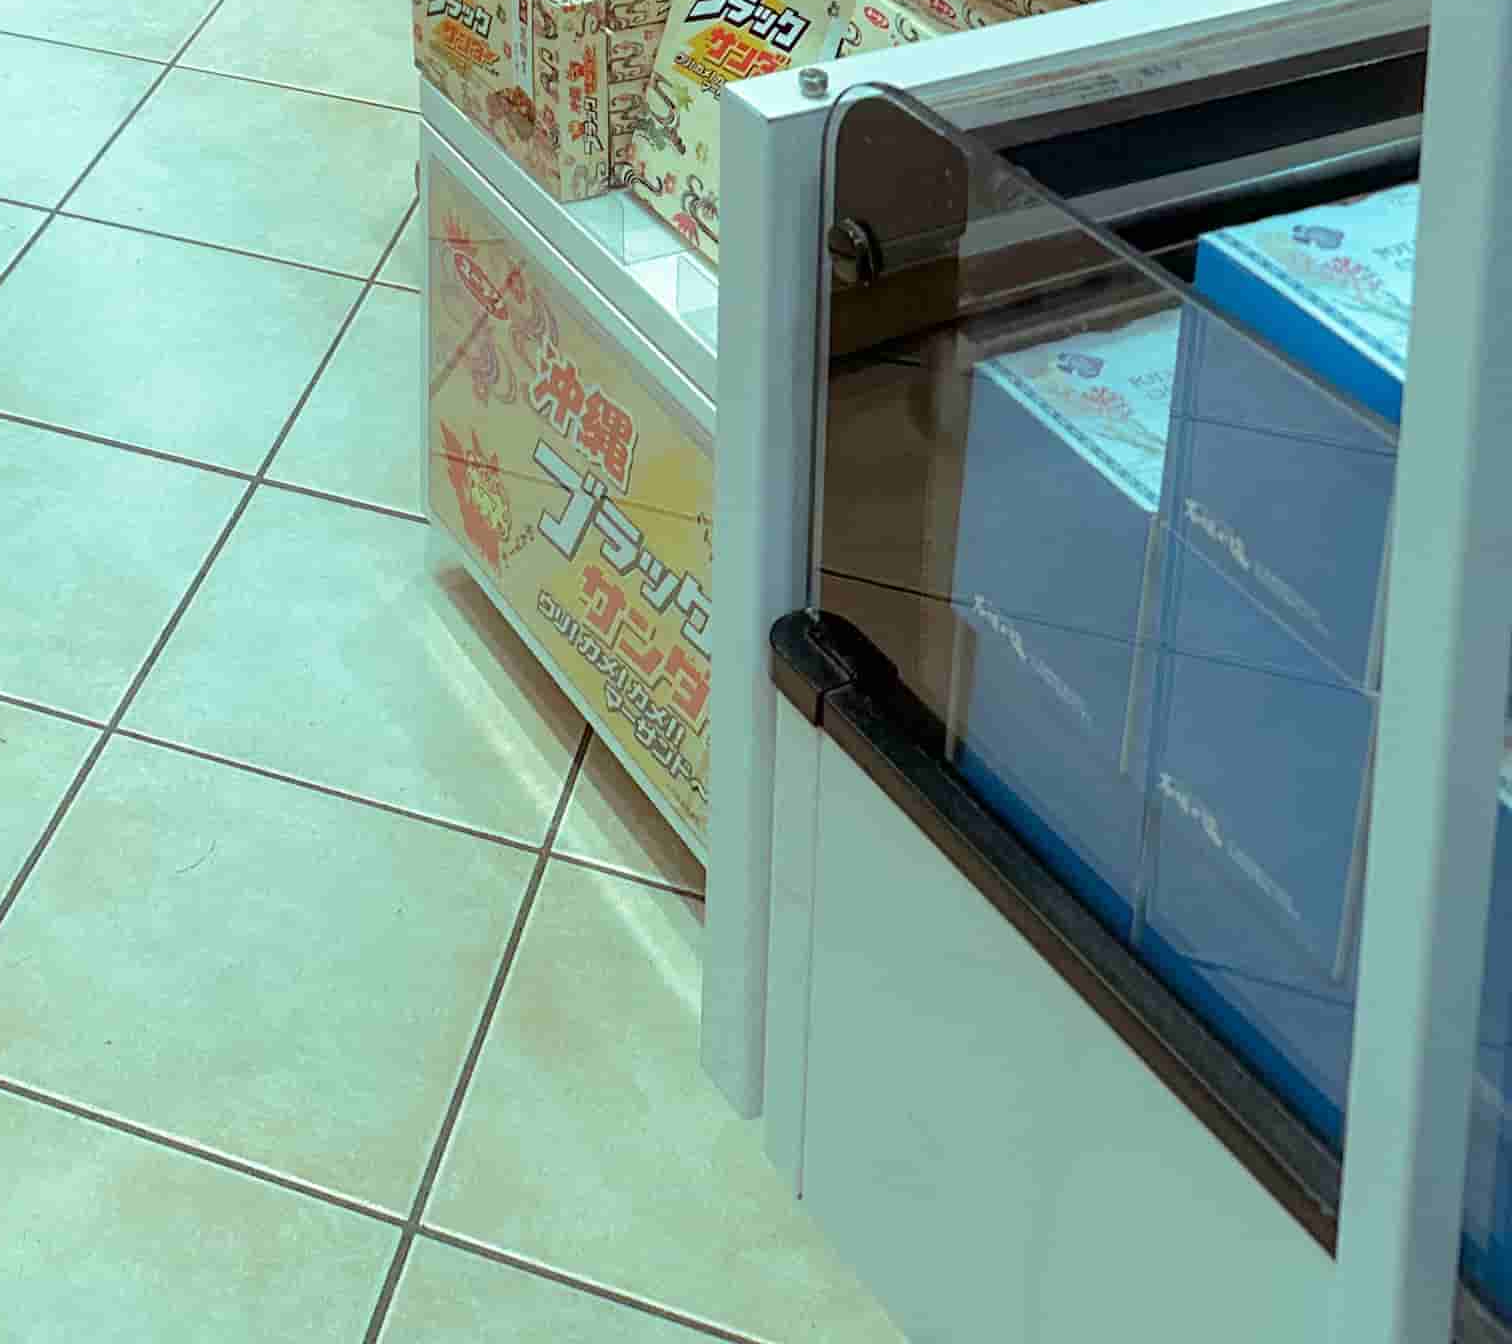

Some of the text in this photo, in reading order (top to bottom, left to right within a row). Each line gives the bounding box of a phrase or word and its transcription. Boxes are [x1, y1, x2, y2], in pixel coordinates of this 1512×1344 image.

[528, 334, 639, 496] 沖縄
[532, 438, 711, 662] ブラック
